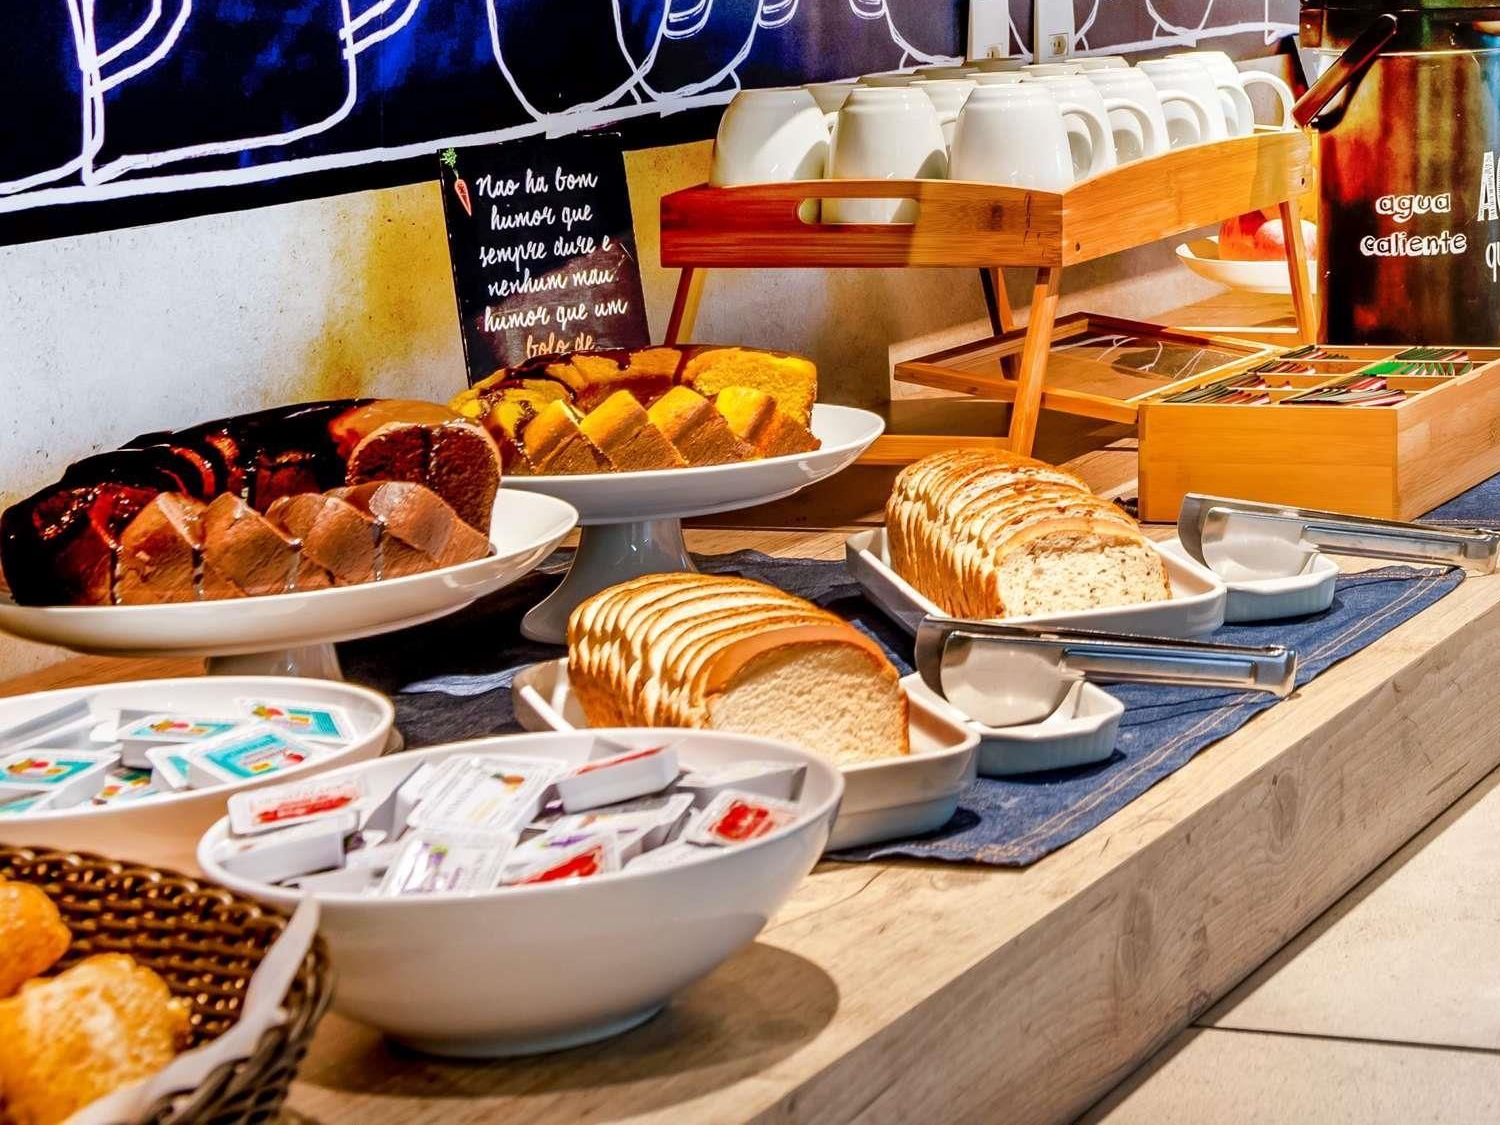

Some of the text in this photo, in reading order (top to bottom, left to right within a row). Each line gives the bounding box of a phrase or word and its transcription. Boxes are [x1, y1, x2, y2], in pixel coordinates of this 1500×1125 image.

[554, 166, 598, 192] bom
[491, 204, 593, 232] humor que
[1375, 192, 1452, 223] agua
[479, 234, 613, 271] sempre dure e
[1359, 230, 1467, 257] caliente
[487, 268, 614, 297] nenhum mau
[484, 298, 628, 333] humor que um
[526, 331, 595, 359] bolo de
